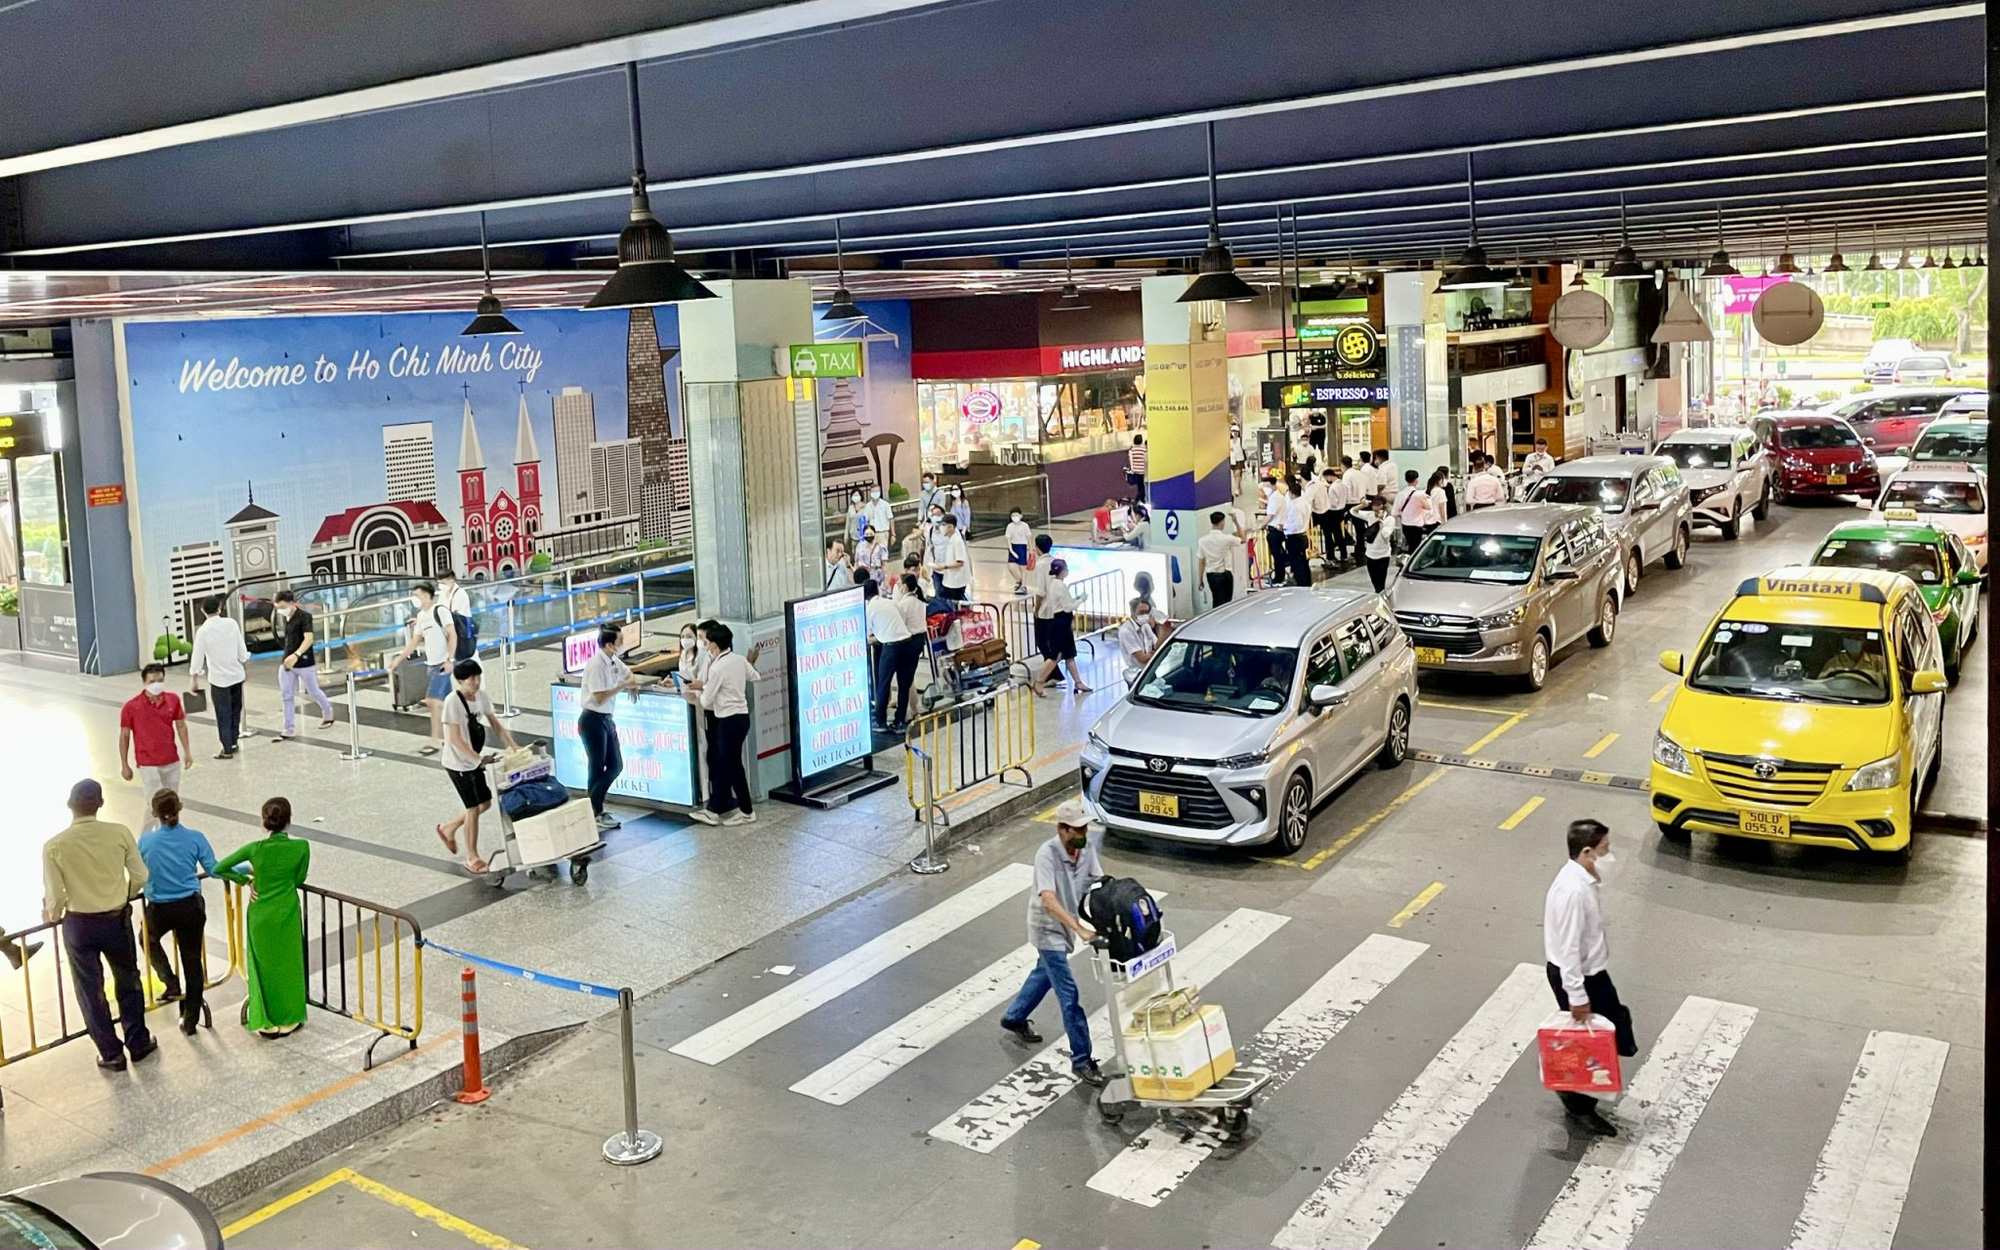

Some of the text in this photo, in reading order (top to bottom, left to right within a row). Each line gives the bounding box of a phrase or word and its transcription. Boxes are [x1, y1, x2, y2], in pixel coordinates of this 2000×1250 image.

[179, 341, 543, 393] Welcome to Ho Chi Minh City
[820, 352, 855, 371] TAXI
[1315, 387, 1369, 400] ESPRESSO
[1166, 515, 1178, 536] 2
[1766, 579, 1852, 595] Vinataxi
[799, 648, 834, 674] TRONG
[812, 741, 863, 769] AIR TICKET
